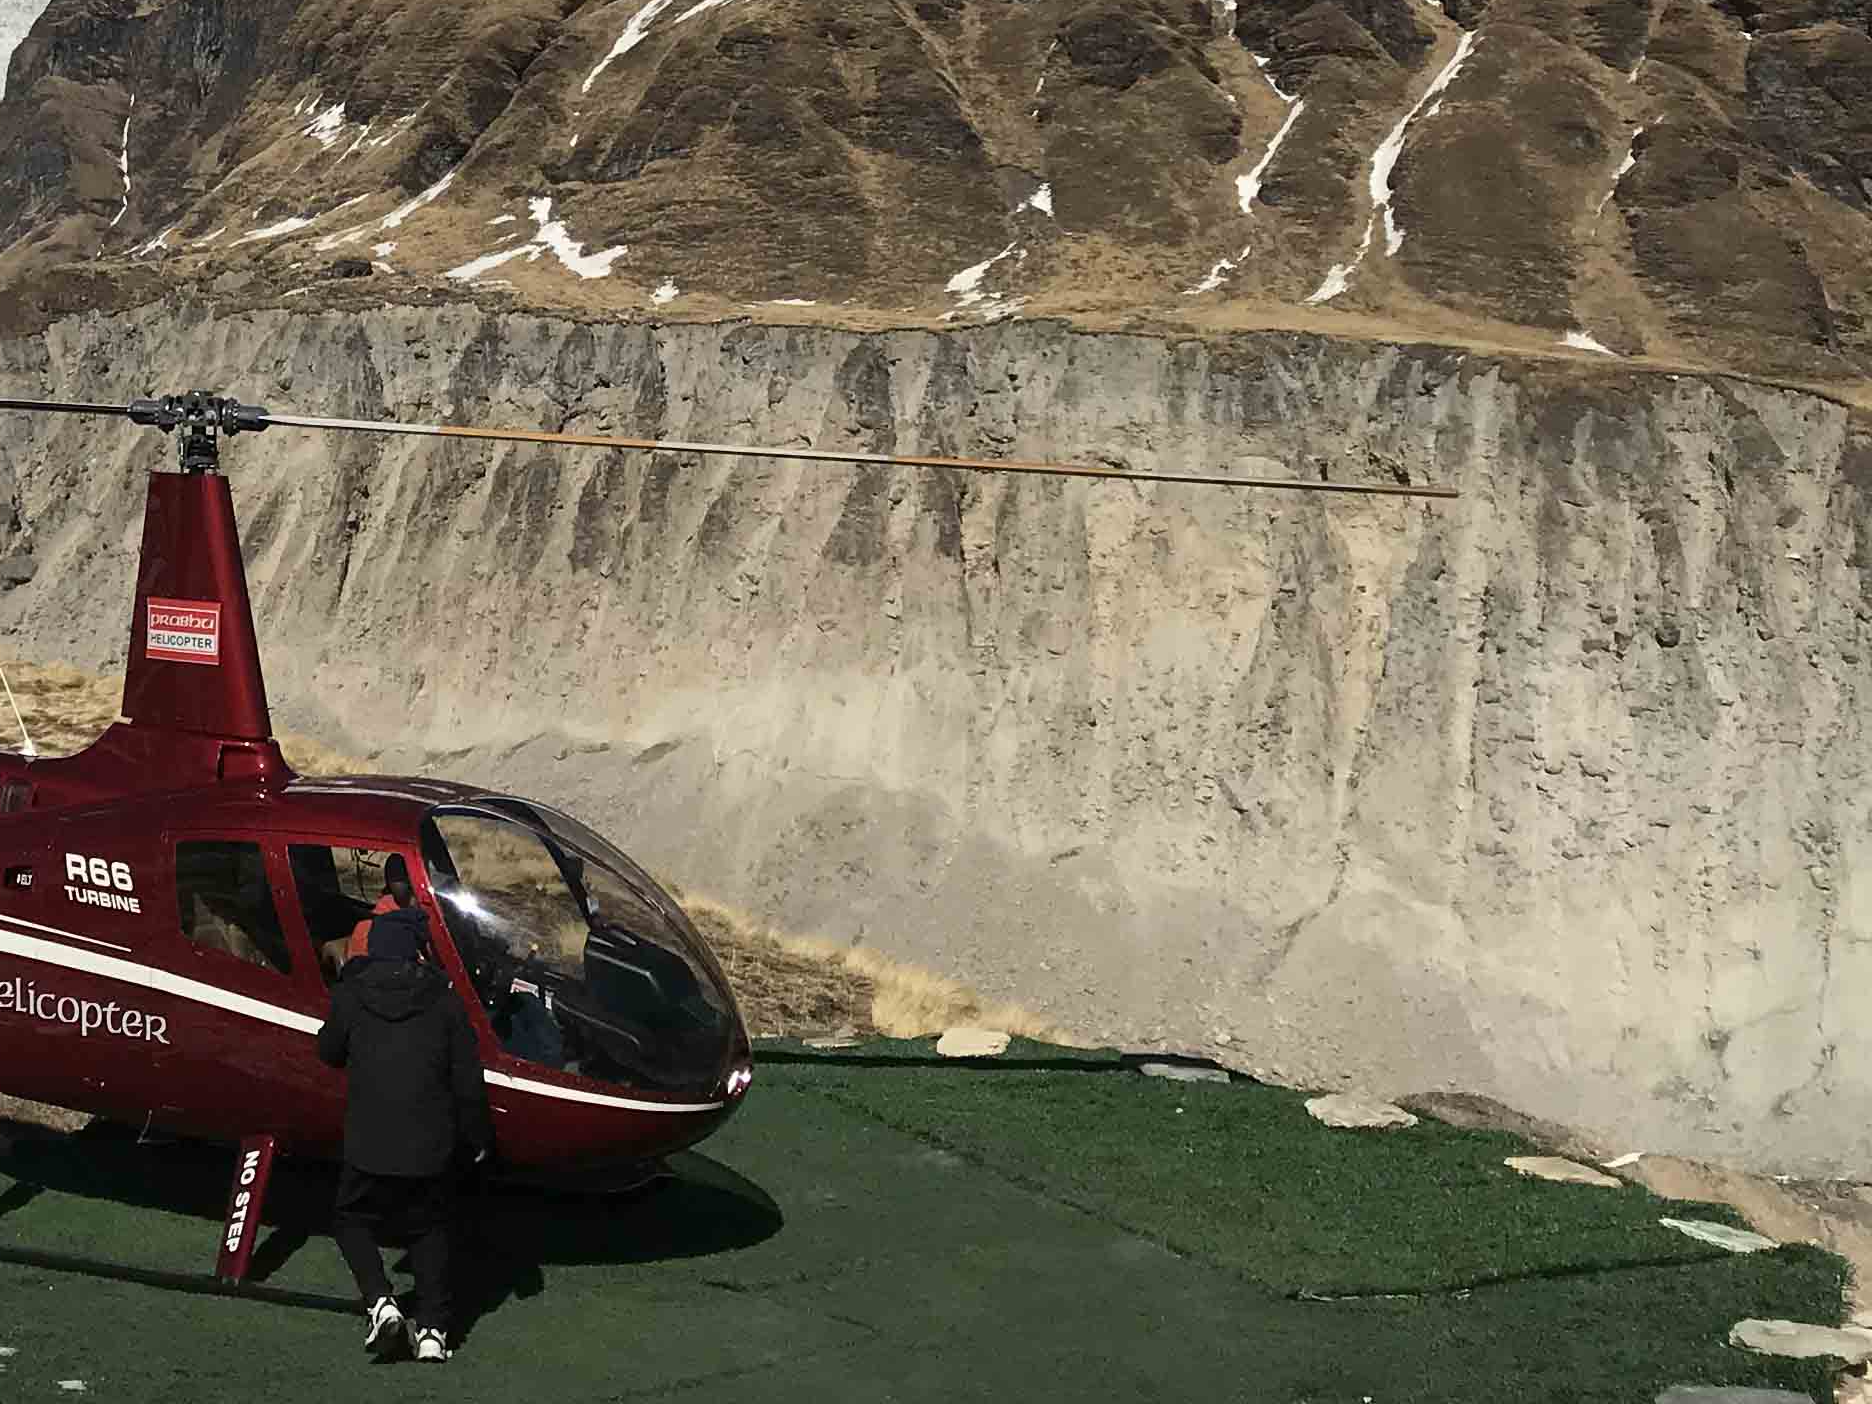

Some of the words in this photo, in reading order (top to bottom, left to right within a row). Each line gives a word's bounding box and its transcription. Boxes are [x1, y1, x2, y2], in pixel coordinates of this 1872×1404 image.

[151, 634, 213, 649] HELICOPTER
[65, 852, 134, 891] R66
[63, 885, 142, 914] TURBINE
[240, 1150, 261, 1185] NO
[225, 1191, 251, 1252] STEP
